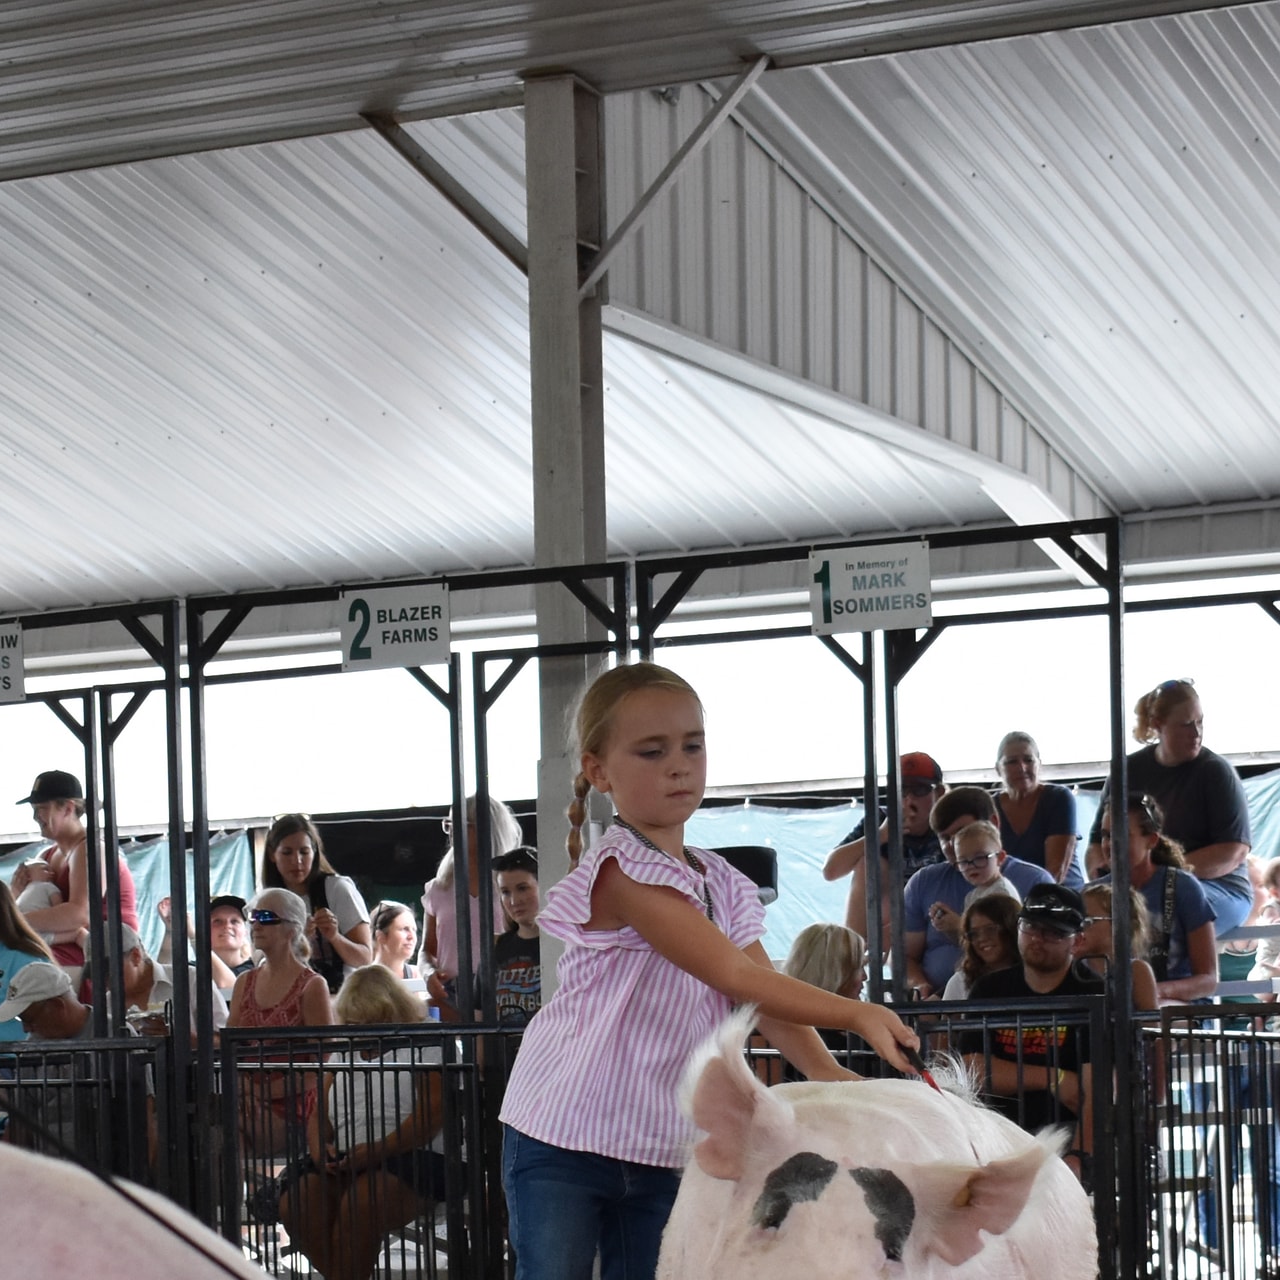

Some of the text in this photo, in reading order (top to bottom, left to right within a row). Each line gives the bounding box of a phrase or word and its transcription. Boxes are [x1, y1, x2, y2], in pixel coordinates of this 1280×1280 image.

[845, 557, 908, 571] In Memory of
[852, 571, 906, 591] MARK
[813, 560, 832, 624] 1
[833, 592, 927, 615] SOMMERS
[376, 605, 442, 624] BLAZER
[348, 598, 372, 661] 2
[382, 627, 438, 645] FARMS
